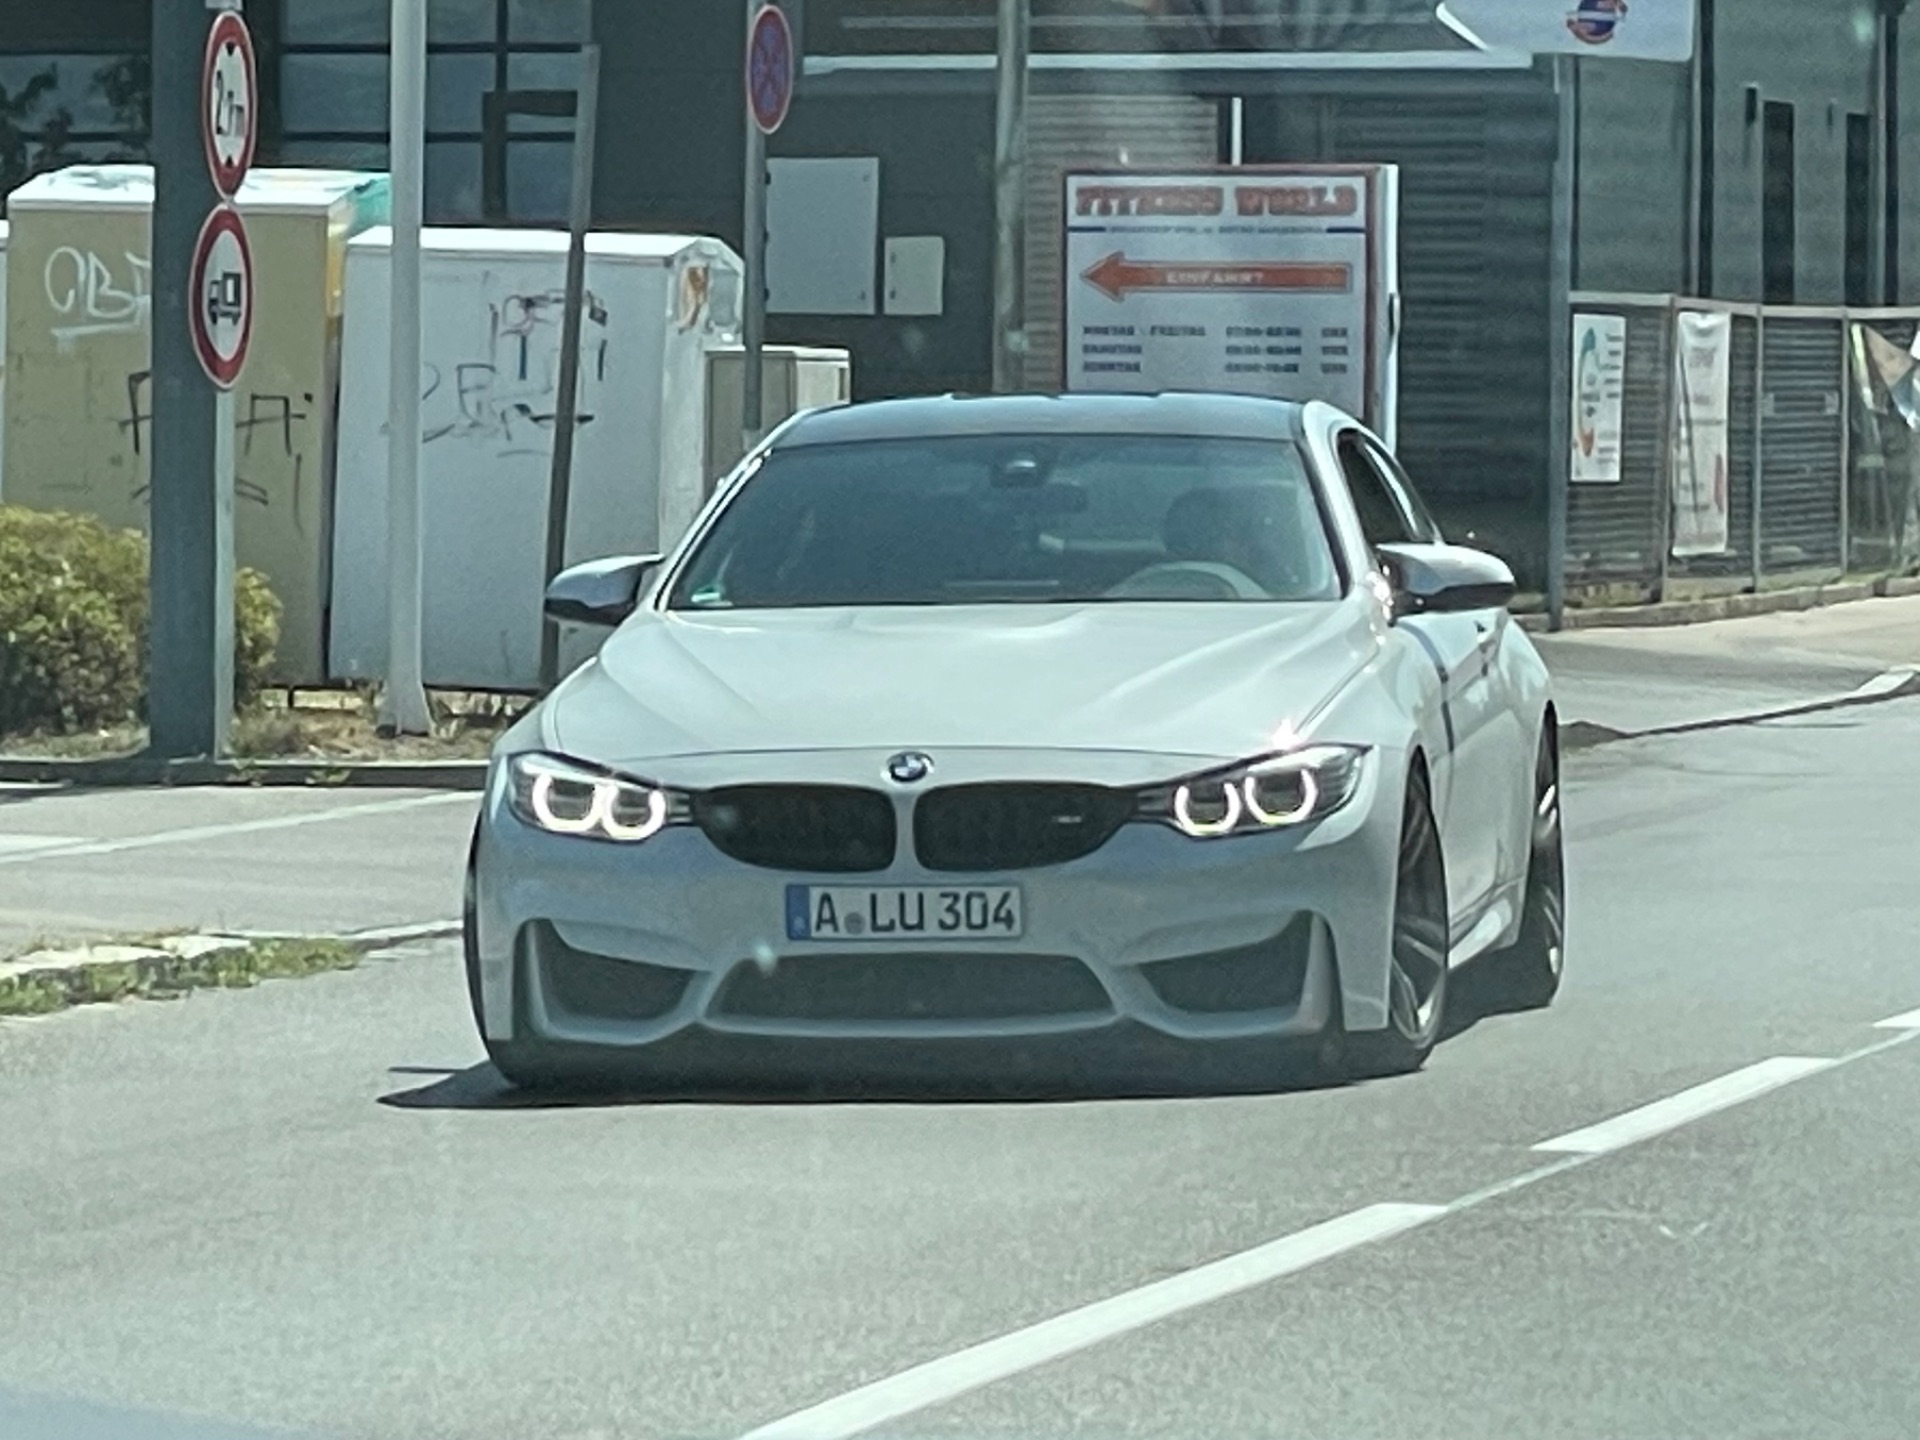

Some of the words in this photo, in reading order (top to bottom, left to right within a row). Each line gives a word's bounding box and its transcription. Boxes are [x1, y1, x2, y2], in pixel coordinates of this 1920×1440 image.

[815, 892, 840, 932] A
[870, 892, 925, 932] LU
[937, 891, 1015, 931] 304
